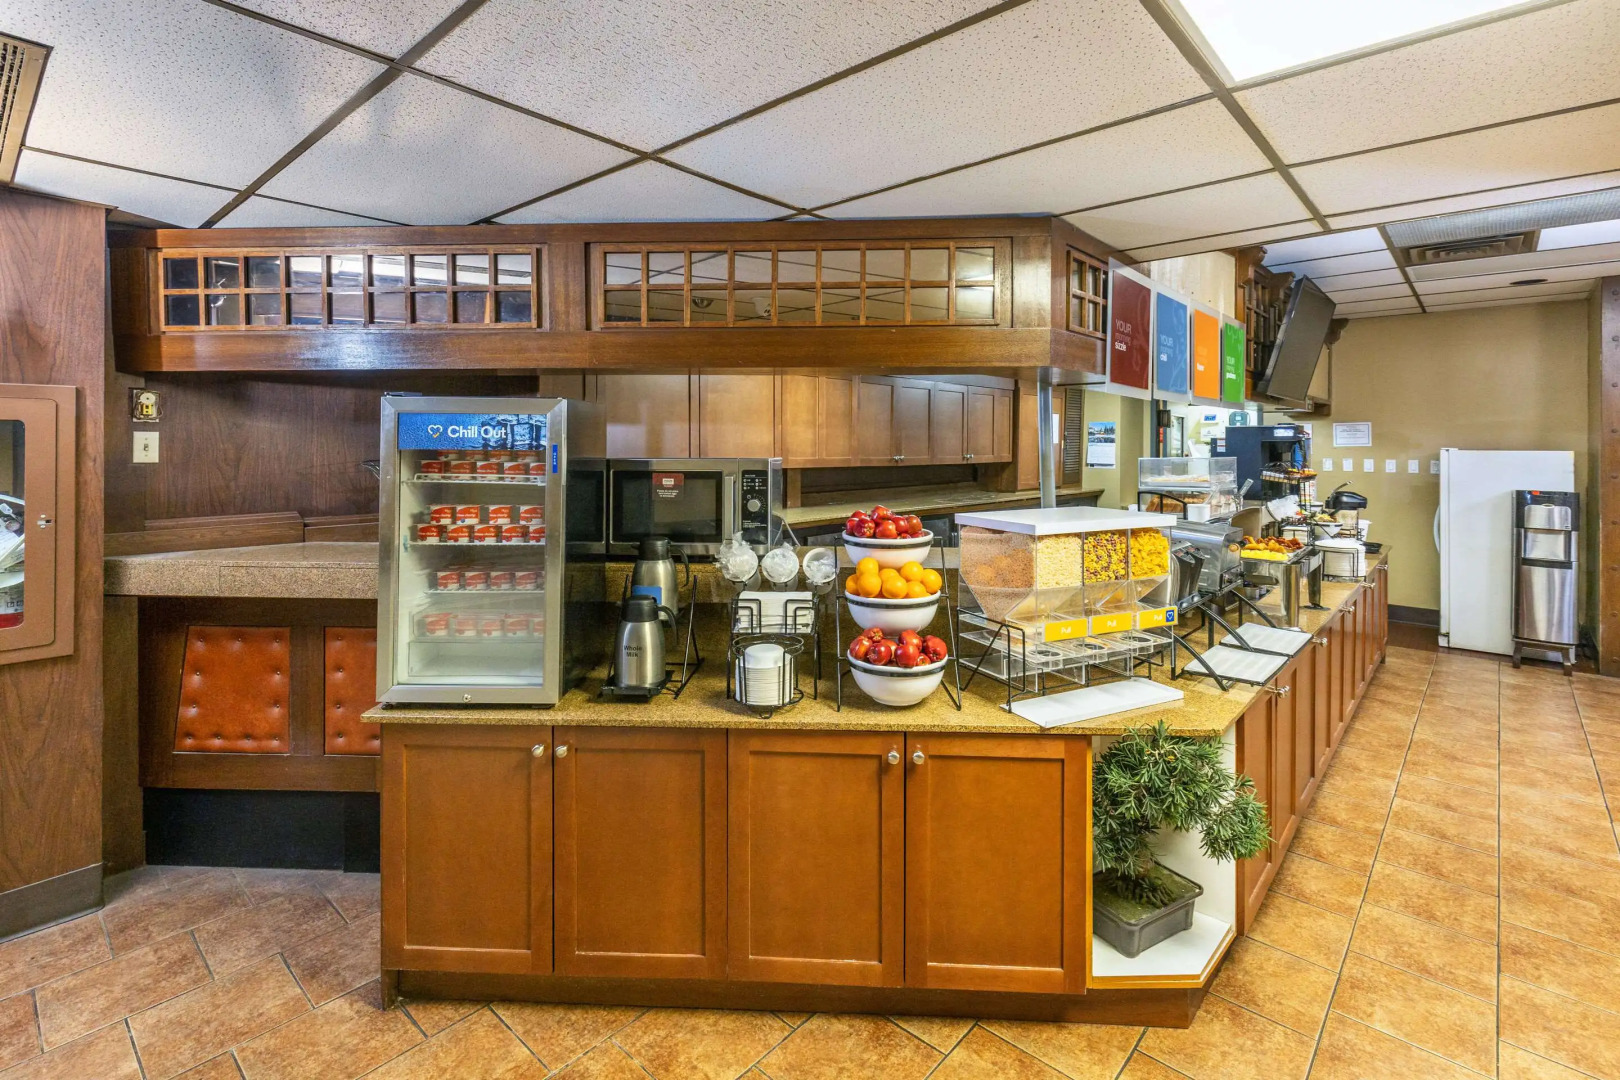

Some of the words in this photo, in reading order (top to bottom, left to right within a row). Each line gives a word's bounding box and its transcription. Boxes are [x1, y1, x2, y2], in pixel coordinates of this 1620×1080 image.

[1115, 319, 1132, 334] YOUR
[1115, 340, 1126, 351] sizzle
[1160, 334, 1173, 347] YOUR
[447, 425, 478, 438] Chill
[480, 425, 507, 438] Out
